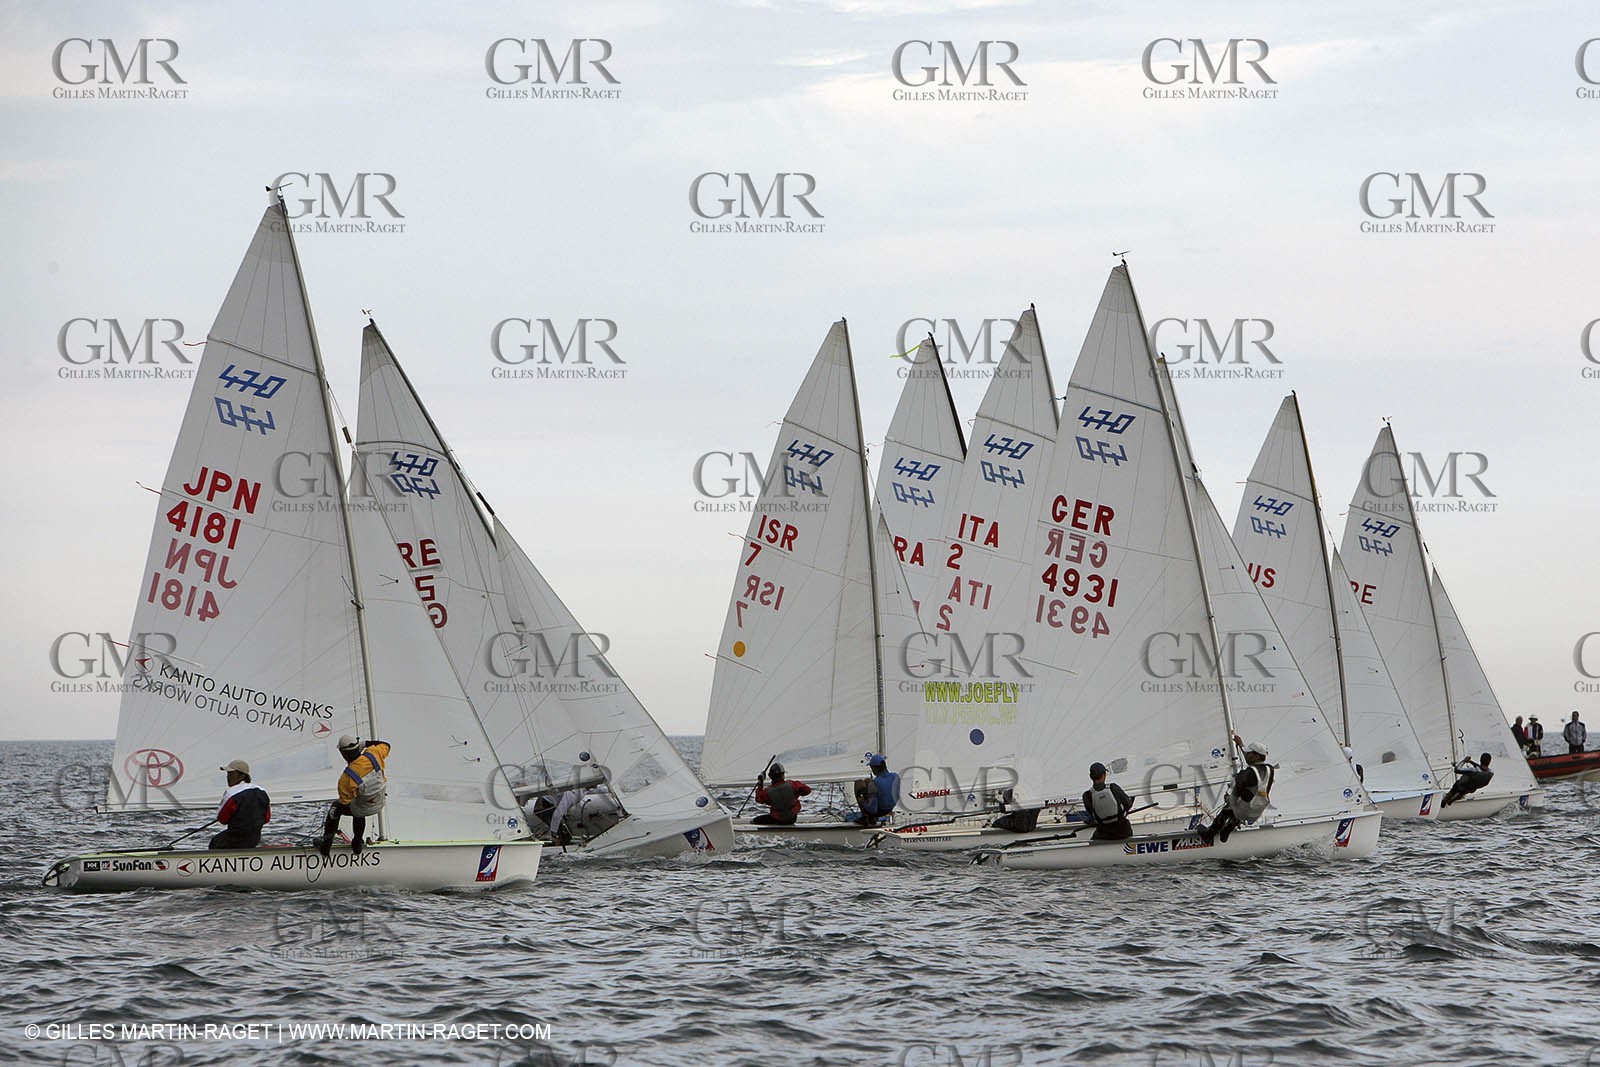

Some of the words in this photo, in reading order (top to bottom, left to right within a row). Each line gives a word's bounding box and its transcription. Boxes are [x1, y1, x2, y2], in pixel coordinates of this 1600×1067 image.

[220, 364, 286, 399] 470
[1078, 406, 1135, 433] 470
[788, 440, 832, 466] 470
[984, 434, 1033, 460] 470
[390, 451, 438, 476] 470
[895, 458, 940, 481] 470
[183, 467, 262, 514] JPN
[1051, 495, 1114, 536] GER
[1254, 496, 1293, 516] 470
[166, 501, 242, 549] 4181
[757, 515, 798, 551] ISR
[958, 513, 999, 548] ITA
[1362, 518, 1399, 538] 470
[745, 542, 762, 566] 7
[947, 543, 963, 569] 2
[1041, 563, 1119, 607] 4931
[160, 663, 216, 693] KANTO
[220, 683, 267, 707] AUTO
[272, 695, 334, 719] WORKS
[917, 789, 951, 799] HARKEN
[1137, 841, 1169, 854] EWE
[113, 860, 152, 871] SunFan
[199, 857, 263, 873] KANTO
[270, 854, 320, 870] AUTO
[323, 852, 380, 868] WORKS
